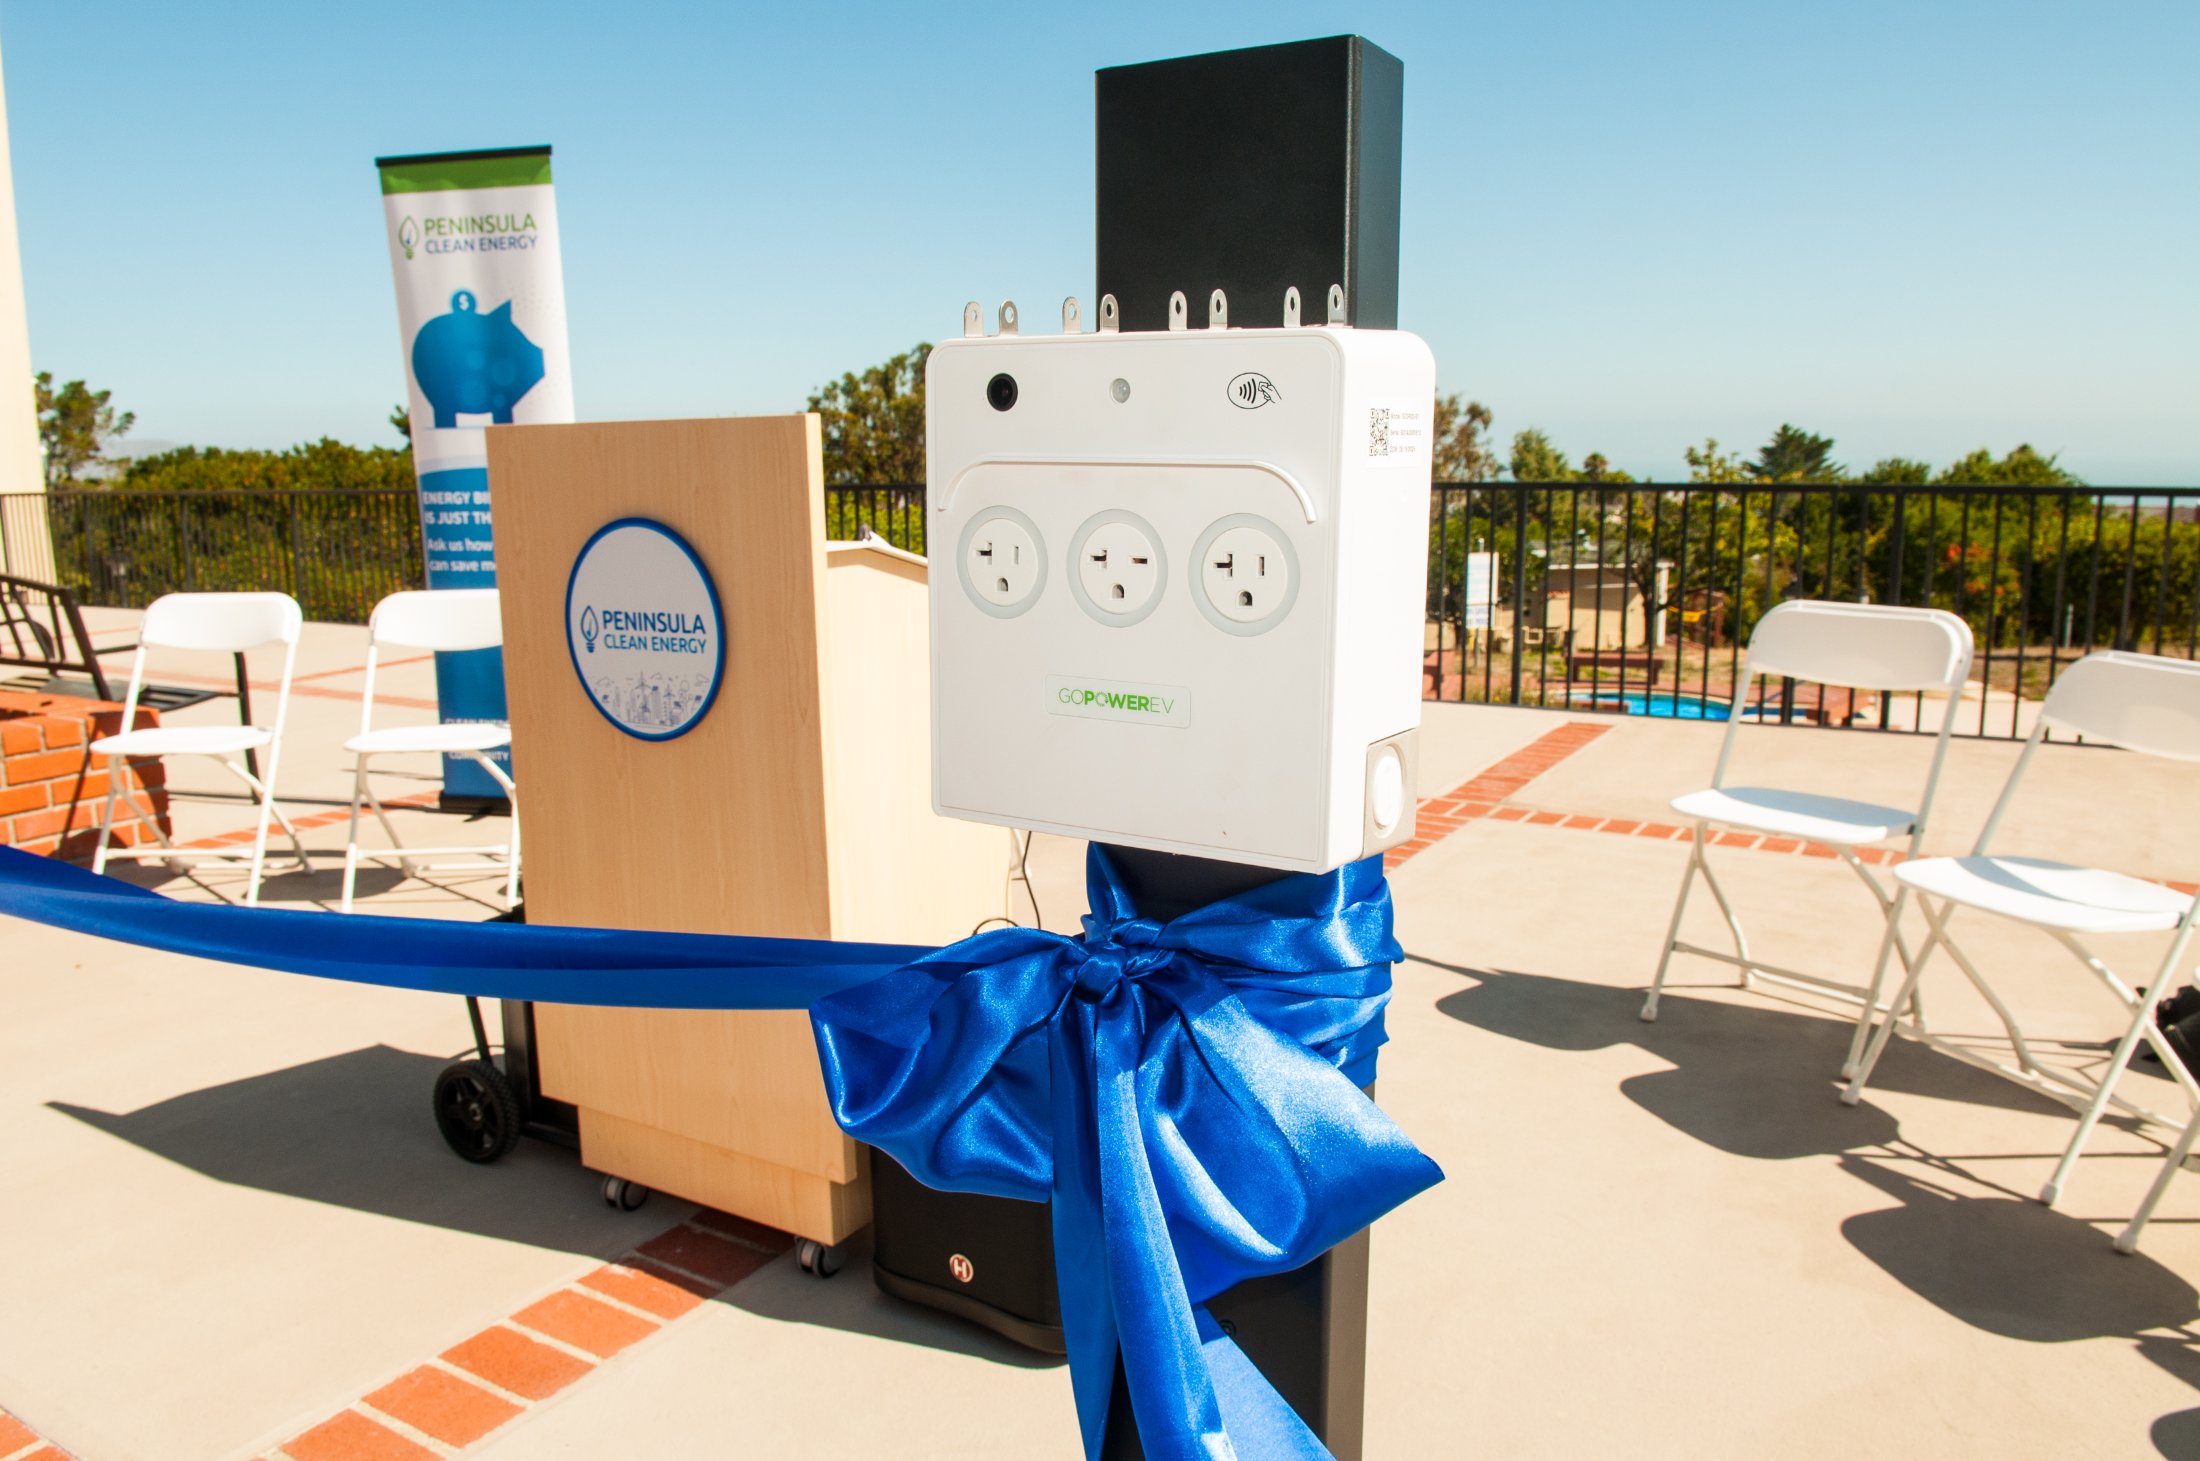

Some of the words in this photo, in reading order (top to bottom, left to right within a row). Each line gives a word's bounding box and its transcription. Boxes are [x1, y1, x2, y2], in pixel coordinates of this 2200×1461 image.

[424, 213, 537, 236] PENINSULA
[425, 239, 475, 254] CLEAN
[480, 236, 537, 252] ENERGY
[422, 491, 470, 505] ENERGY
[424, 511, 435, 524] IS
[438, 511, 469, 525] JUST
[472, 511, 493, 525] TH
[427, 538, 446, 551] Ask
[448, 541, 464, 551] us
[429, 560, 449, 571] can
[450, 560, 479, 572] save
[602, 610, 706, 635] PENINSULA
[604, 635, 648, 651] CLEAN
[652, 636, 707, 654] ENERGY
[1058, 687, 1175, 714] GOPOWEREV
